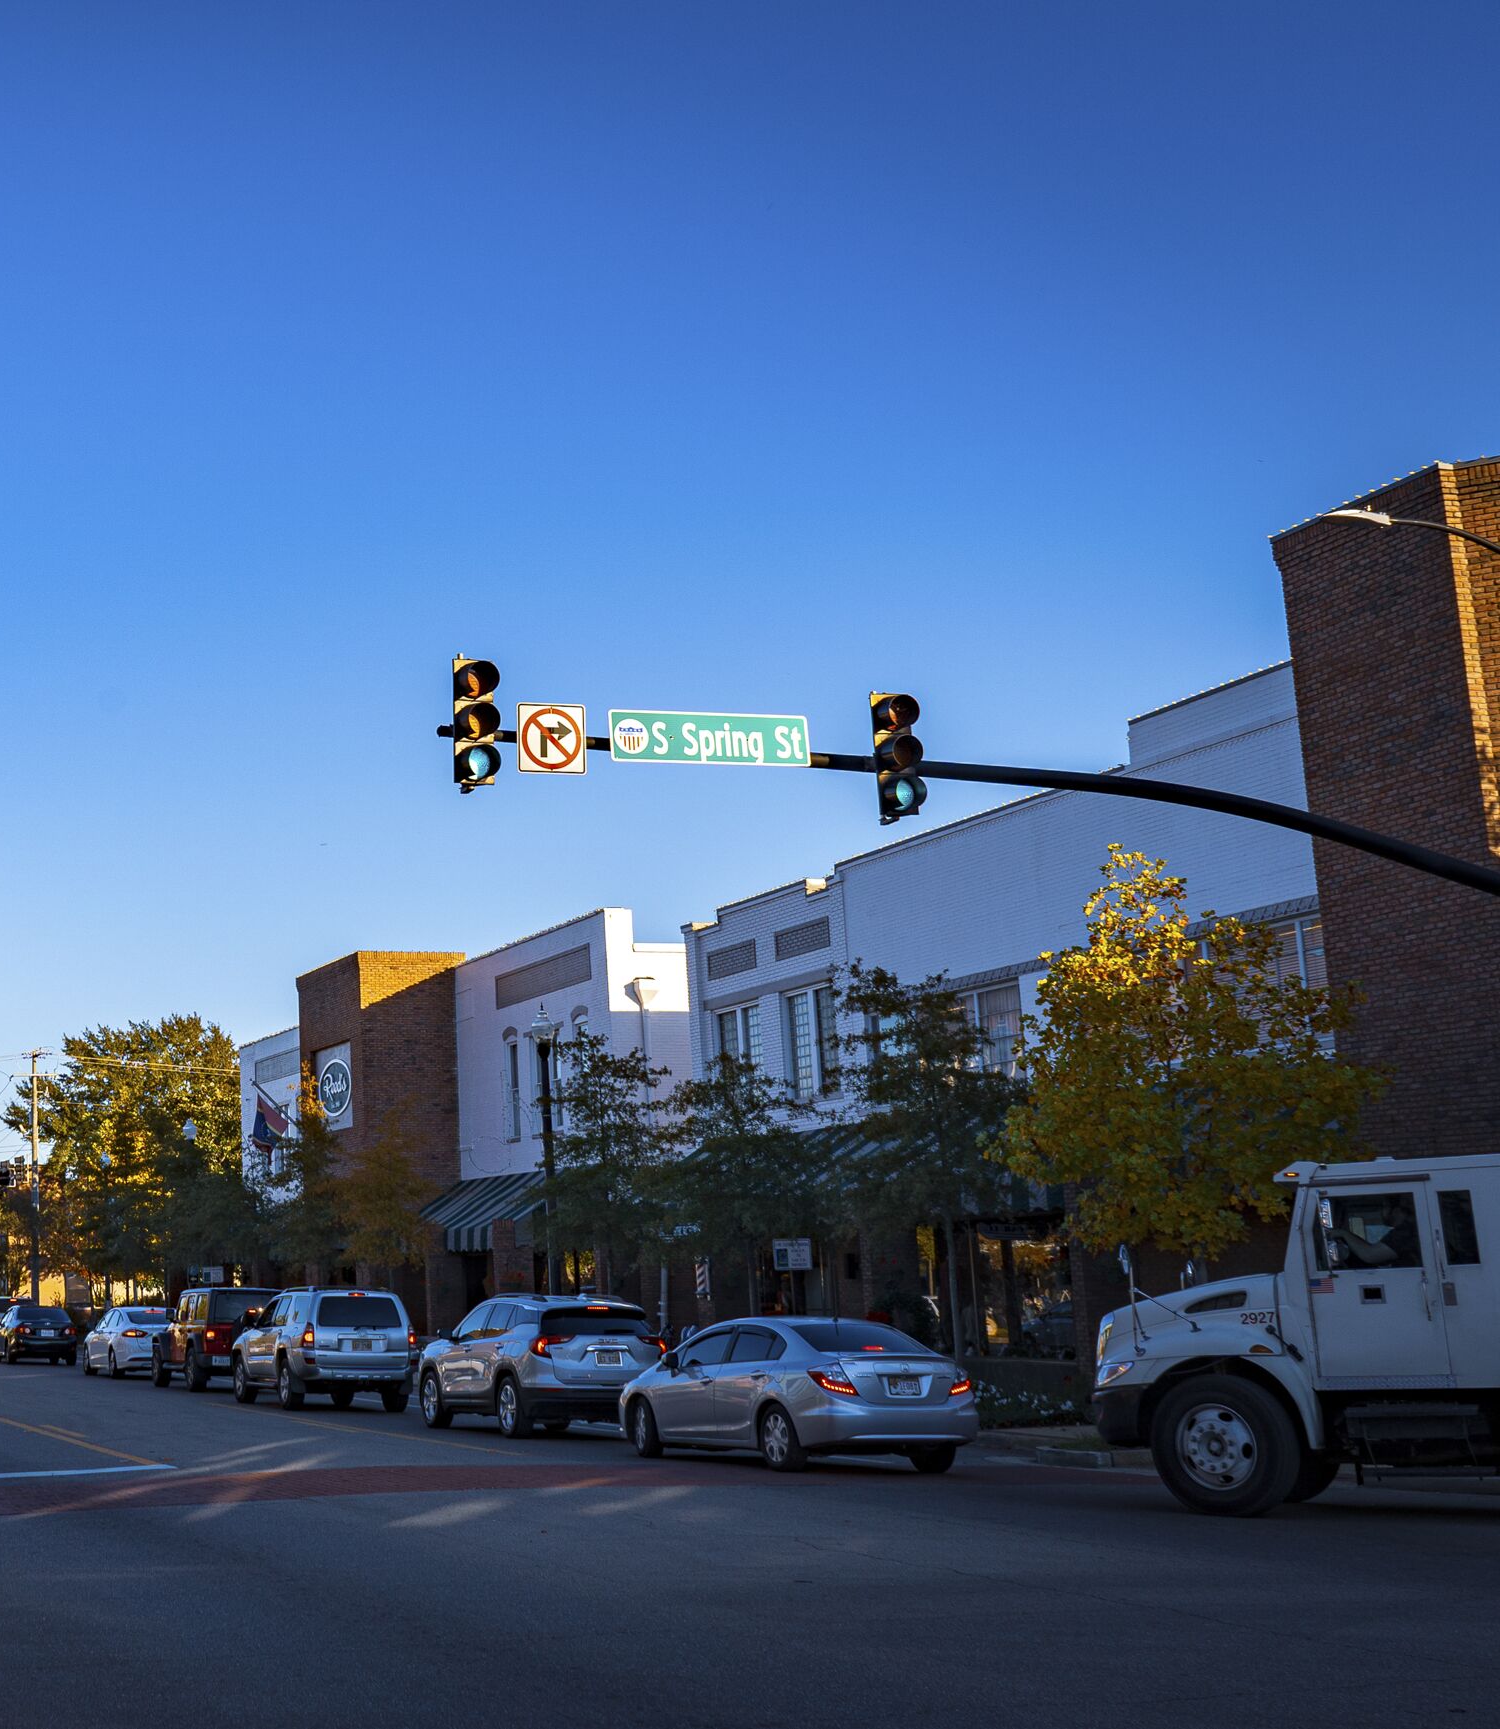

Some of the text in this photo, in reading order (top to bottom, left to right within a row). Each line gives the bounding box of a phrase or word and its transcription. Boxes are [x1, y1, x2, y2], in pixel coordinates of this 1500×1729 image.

[651, 721, 804, 764] S Spring St
[1240, 1311, 1275, 1325] 2927
